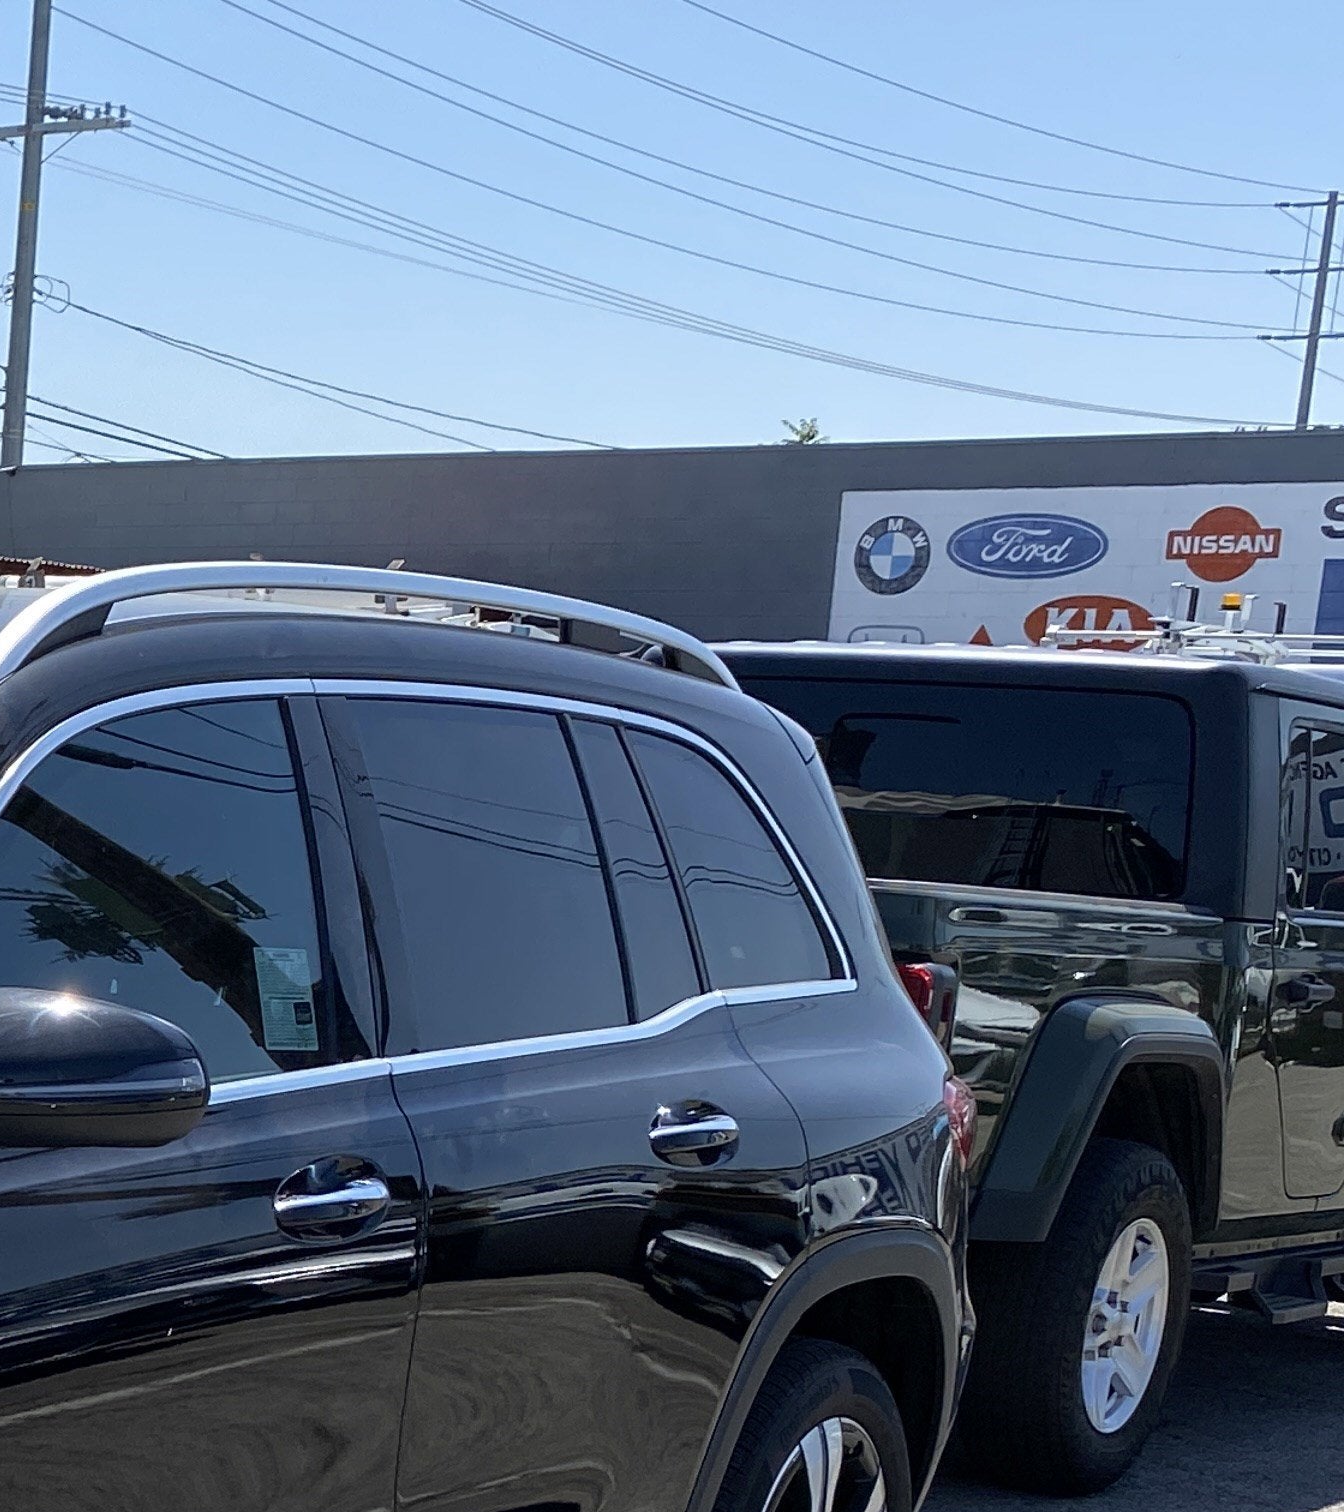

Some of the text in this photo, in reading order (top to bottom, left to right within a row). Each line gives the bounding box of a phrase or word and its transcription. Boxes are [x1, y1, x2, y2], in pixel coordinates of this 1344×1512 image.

[859, 518, 929, 549] BMW
[980, 526, 1074, 564] Ford
[1171, 533, 1276, 555] NISSAN
[1044, 606, 1134, 641] KIA
